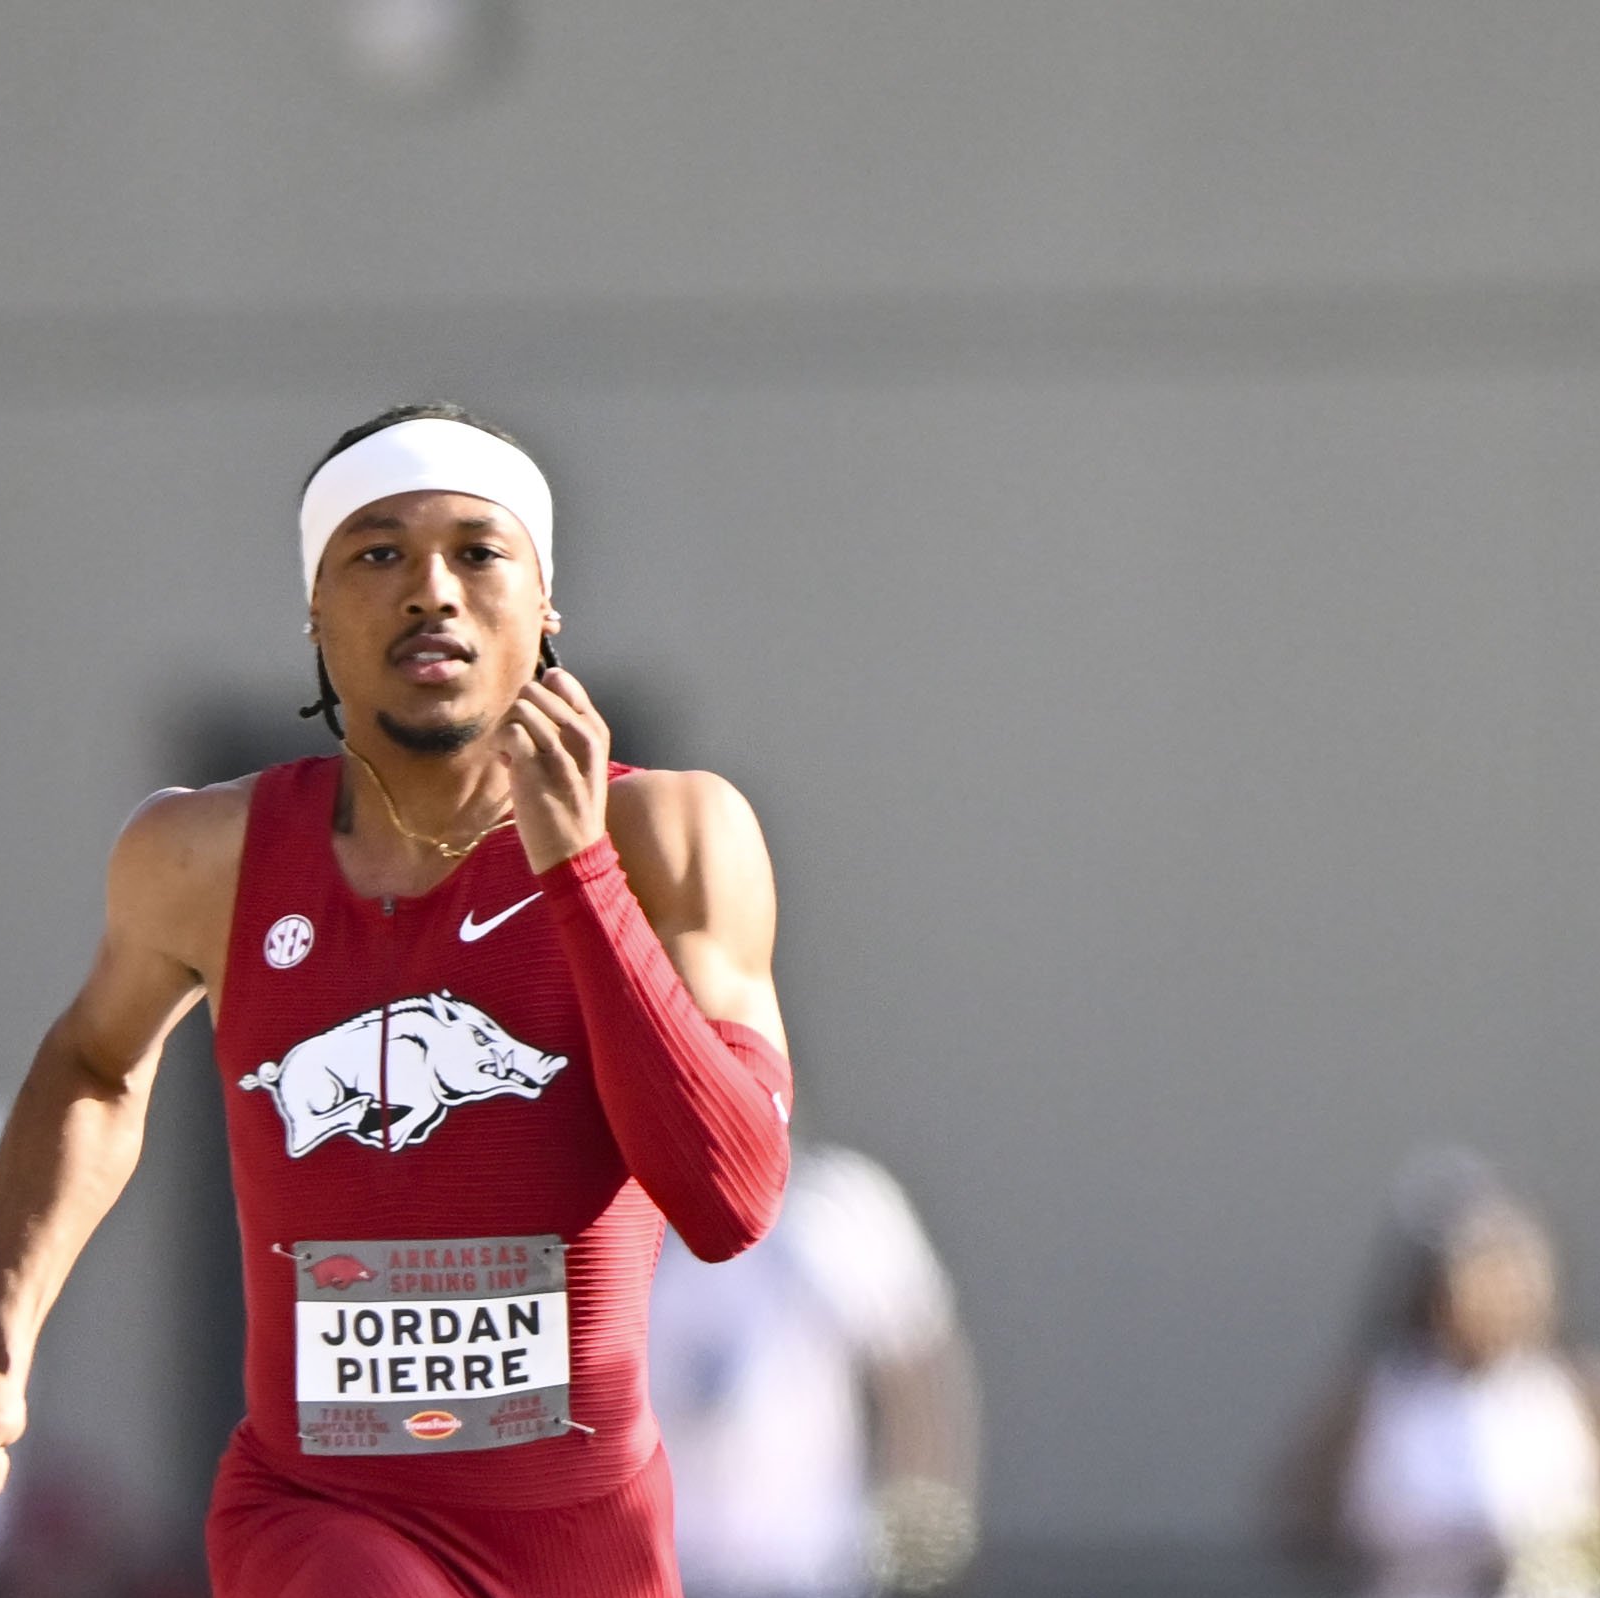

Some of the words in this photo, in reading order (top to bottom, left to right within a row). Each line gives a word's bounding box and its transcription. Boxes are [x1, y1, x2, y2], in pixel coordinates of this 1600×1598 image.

[268, 918, 311, 965] SEC
[389, 1246, 527, 1268] ARKANSAS
[389, 1271, 476, 1293] SPRING
[488, 1269, 527, 1288] INV
[321, 1301, 540, 1347] JORDAN
[337, 1348, 529, 1394] PIERRE
